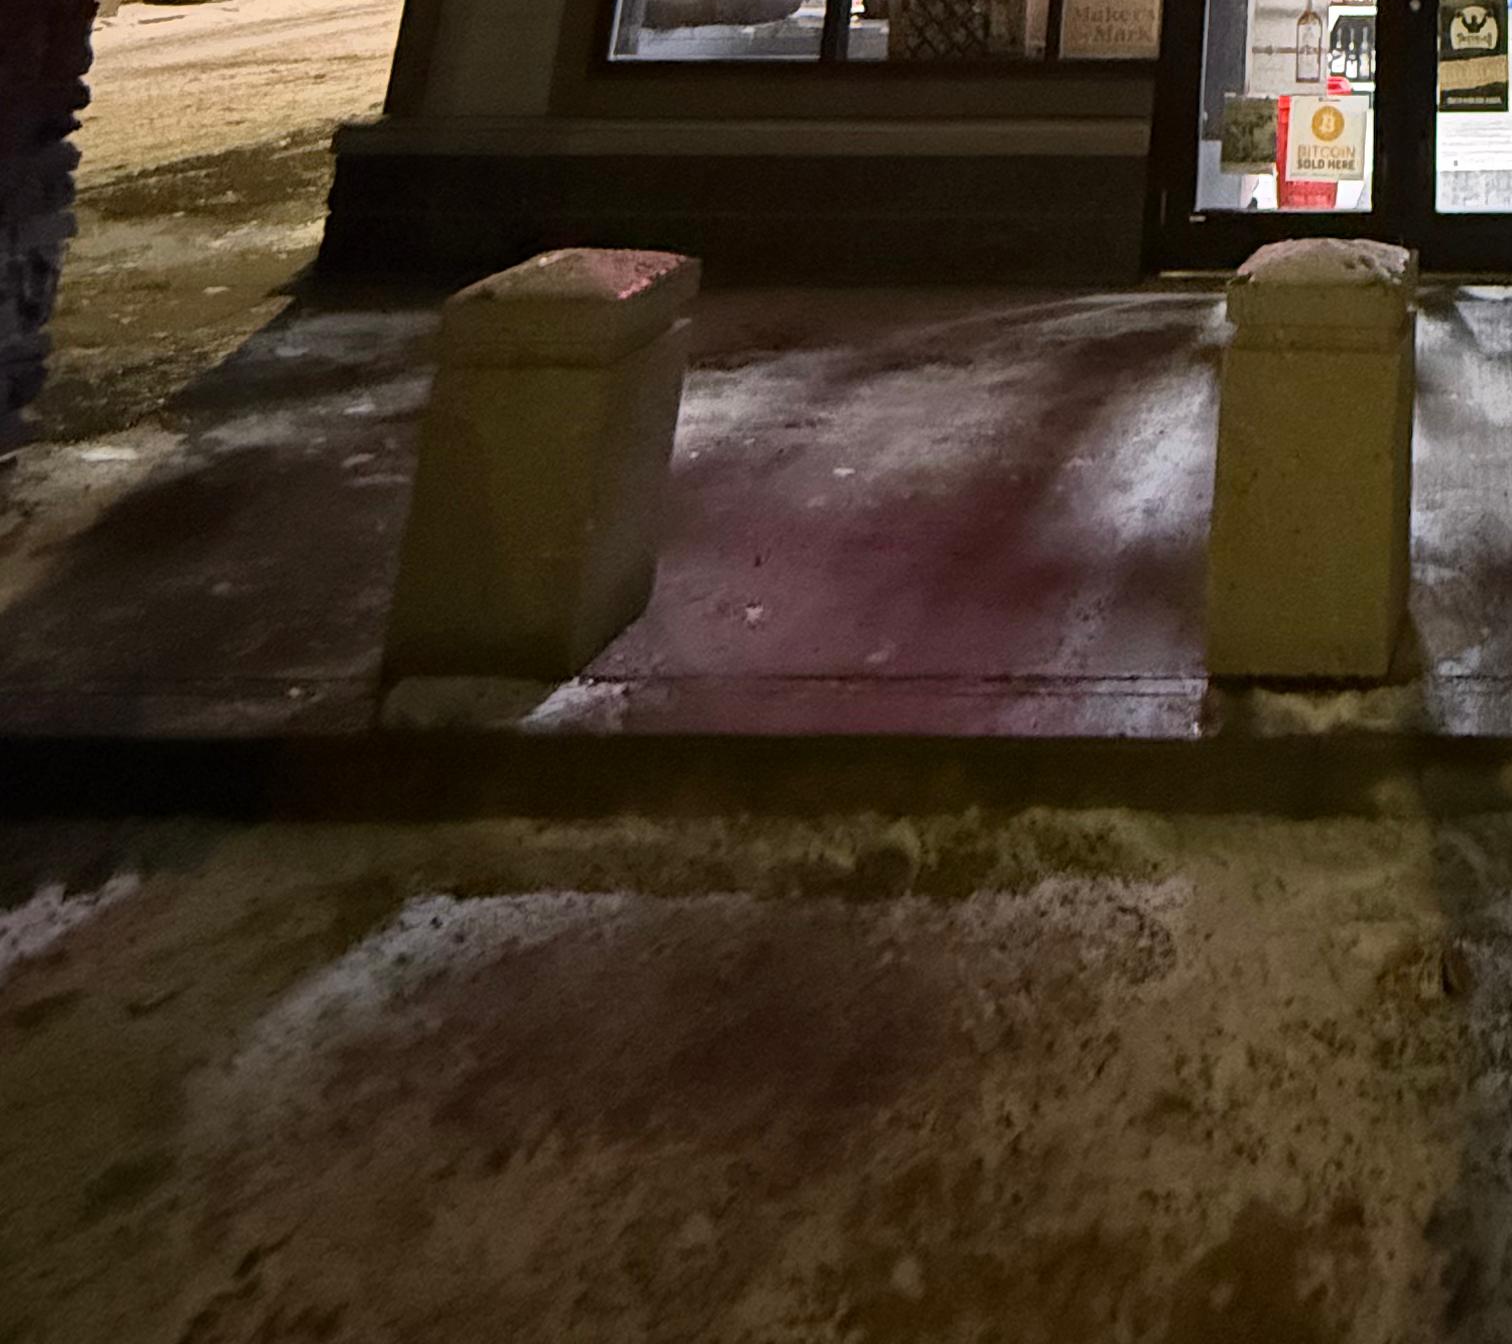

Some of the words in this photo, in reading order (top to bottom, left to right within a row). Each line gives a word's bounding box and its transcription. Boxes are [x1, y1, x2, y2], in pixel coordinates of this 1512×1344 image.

[1297, 143, 1356, 159] BITCOIN
[1297, 158, 1326, 170] SOLD
[1327, 159, 1356, 170] HERE
